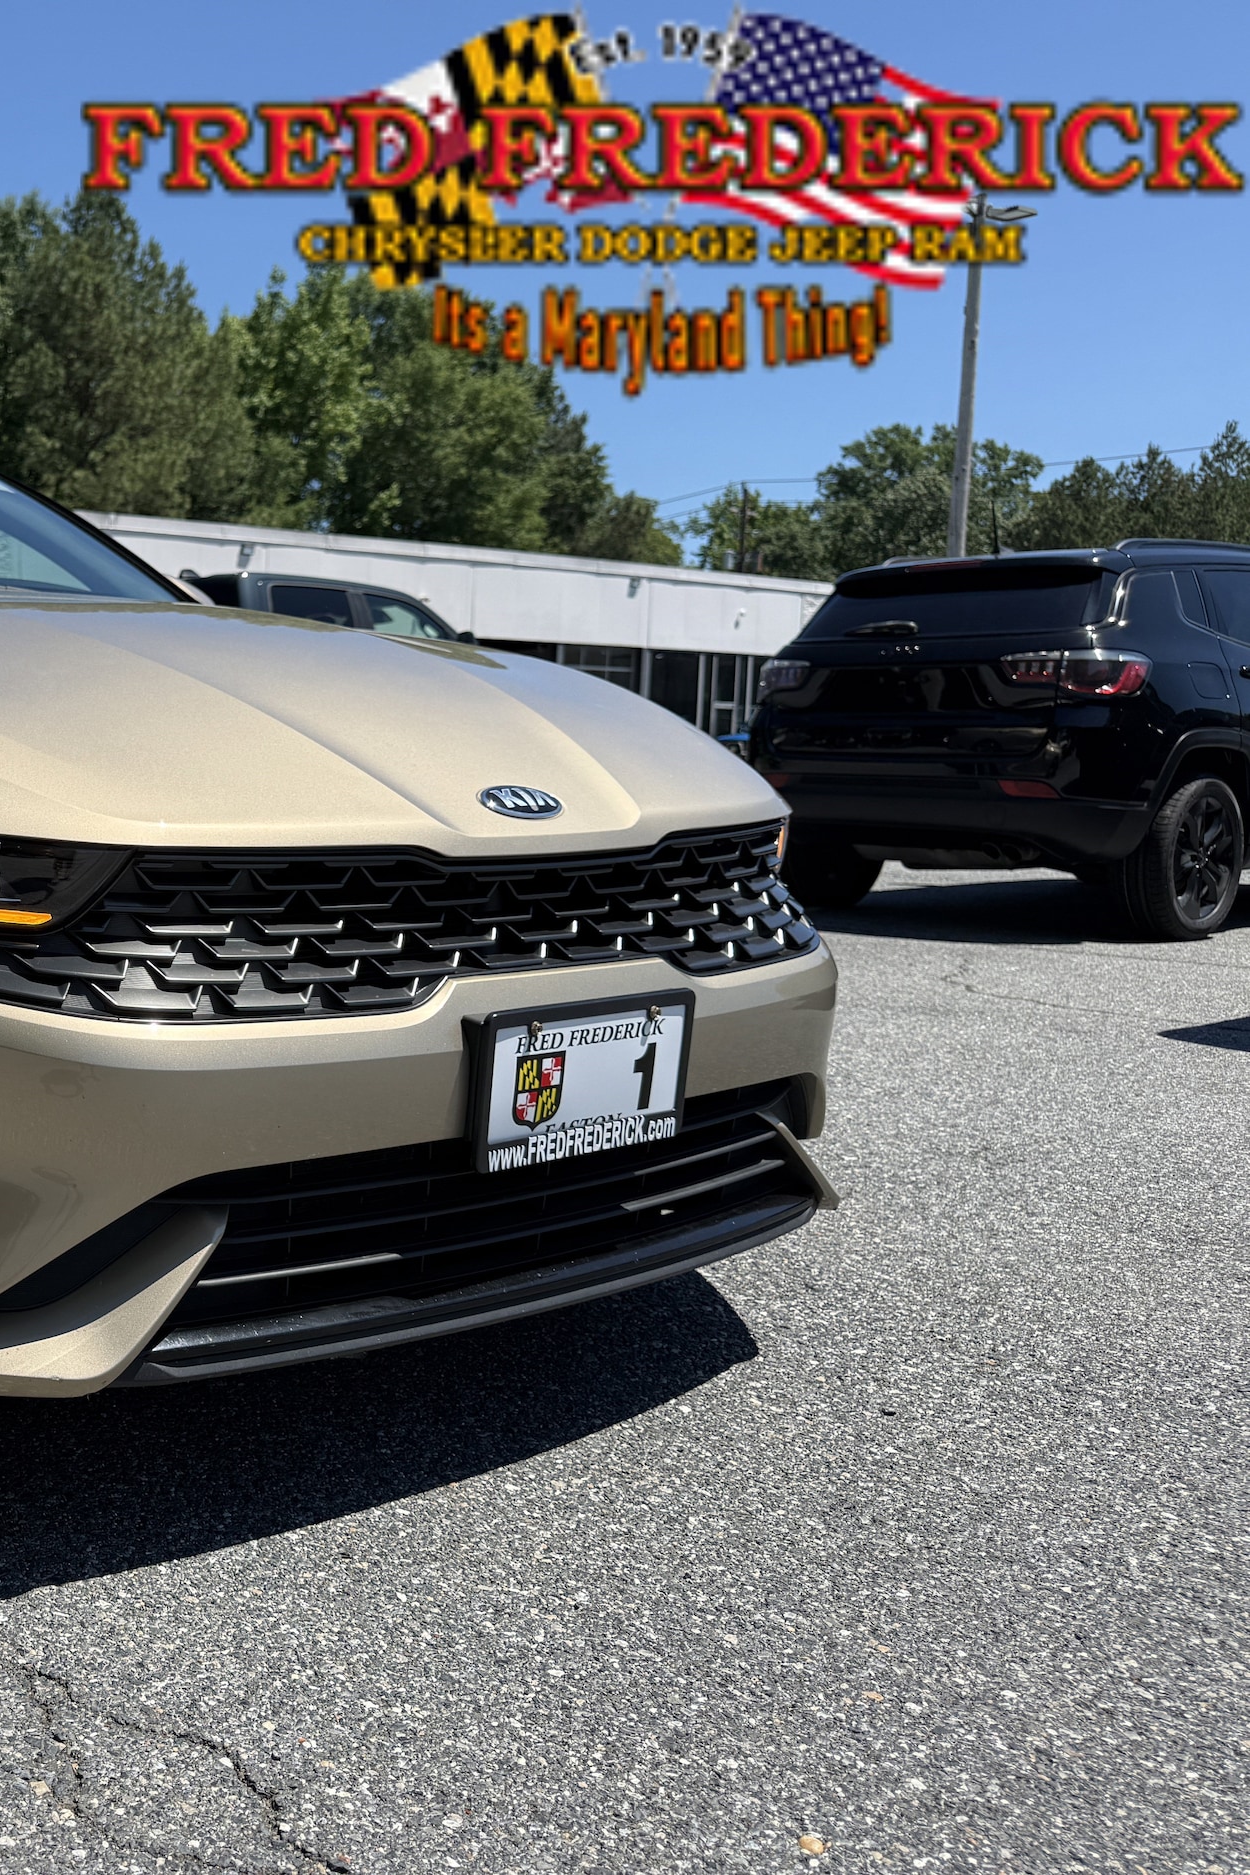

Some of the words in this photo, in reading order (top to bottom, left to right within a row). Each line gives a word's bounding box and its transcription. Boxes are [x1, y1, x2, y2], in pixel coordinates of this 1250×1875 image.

[488, 786, 558, 812] KIA
[515, 1031, 564, 1054] FRED
[568, 1017, 666, 1047] FREDERICK
[632, 1041, 658, 1111] 1
[487, 1115, 676, 1173] www.FREDFREDERICK.com
